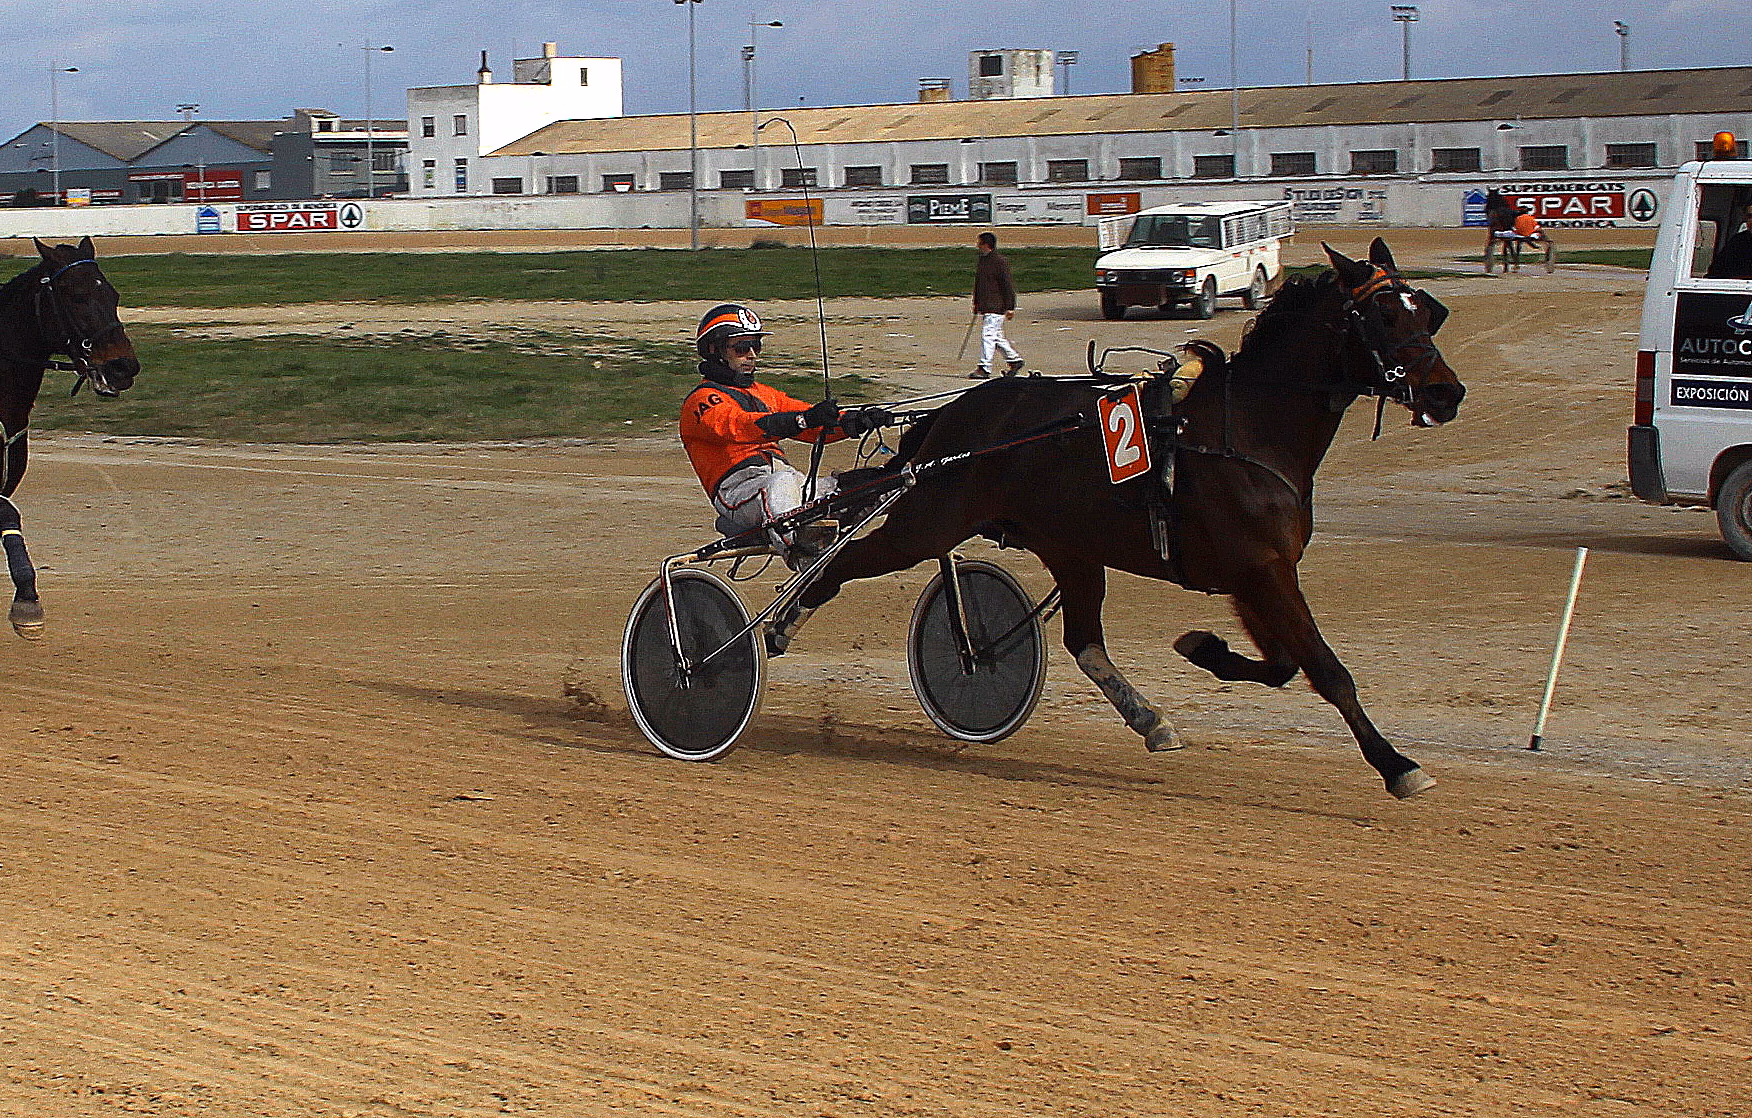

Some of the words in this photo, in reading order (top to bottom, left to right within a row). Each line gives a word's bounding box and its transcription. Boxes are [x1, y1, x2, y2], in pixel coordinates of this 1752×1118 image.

[1500, 182, 1626, 194] SUPERMERCATS
[1515, 196, 1614, 215] SPAR
[249, 212, 330, 229] SPAR
[1676, 386, 1749, 402] EXPOSICIÓN
[1109, 402, 1140, 468] 2
